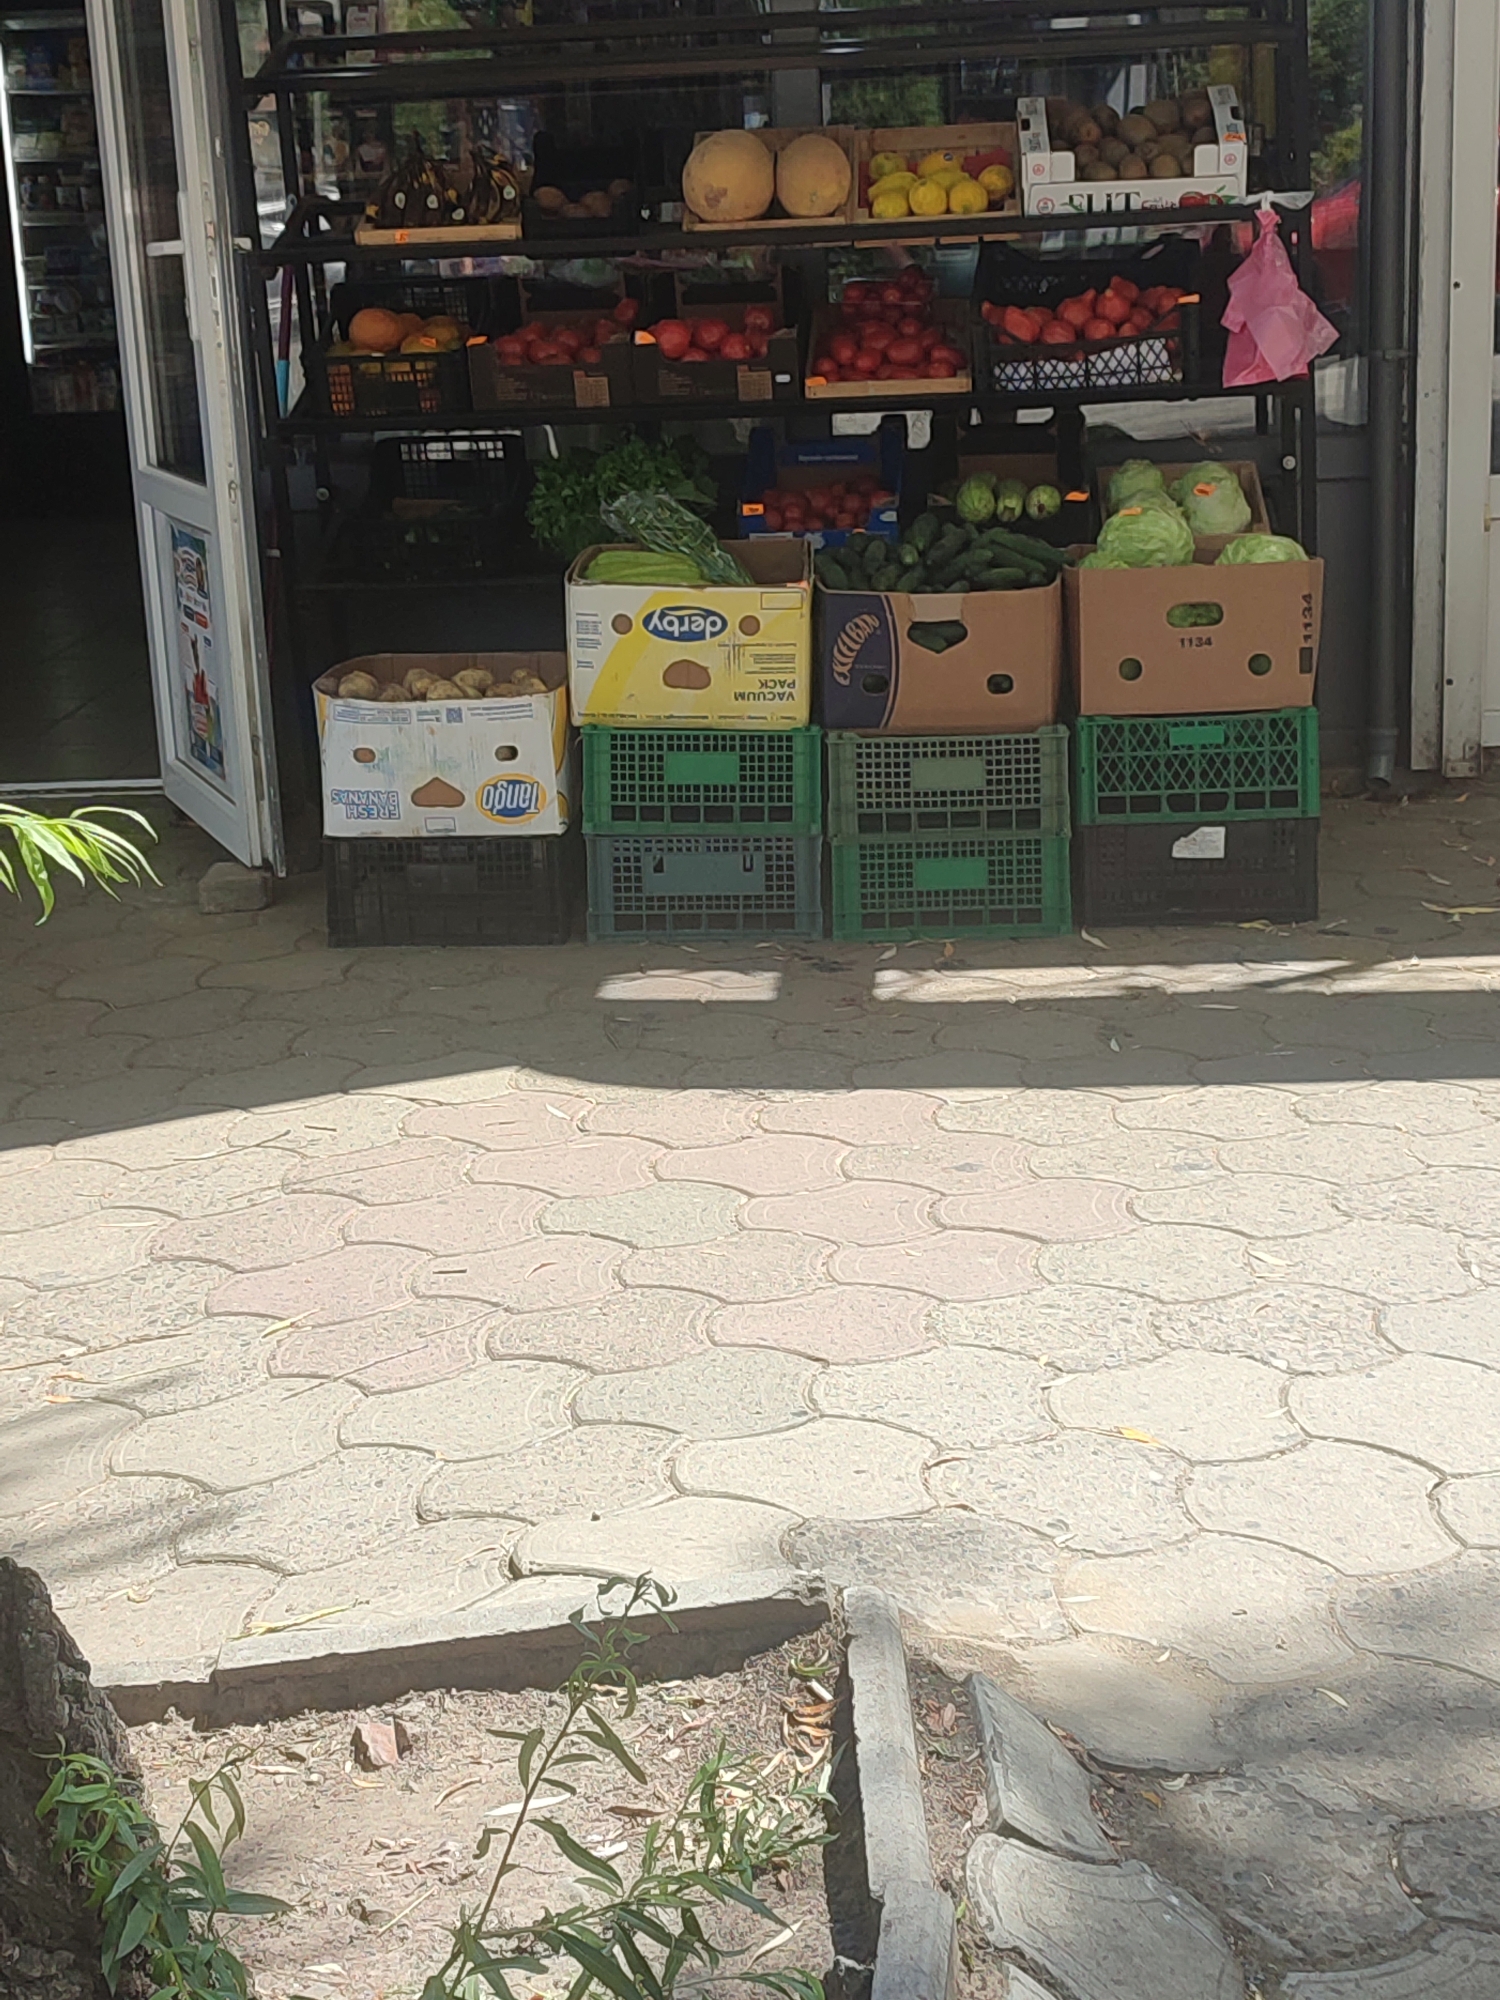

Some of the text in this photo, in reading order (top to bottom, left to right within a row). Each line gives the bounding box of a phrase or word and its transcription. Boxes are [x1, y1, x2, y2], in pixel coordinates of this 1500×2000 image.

[648, 609, 722, 640] derby
[1301, 593, 1313, 643] 1134
[1178, 636, 1213, 648] 1134
[758, 678, 796, 690] PACK
[733, 690, 796, 702] VACUUM
[331, 788, 399, 806] BANANAS
[482, 780, 540, 815] Tango
[345, 804, 401, 821] FRESH
